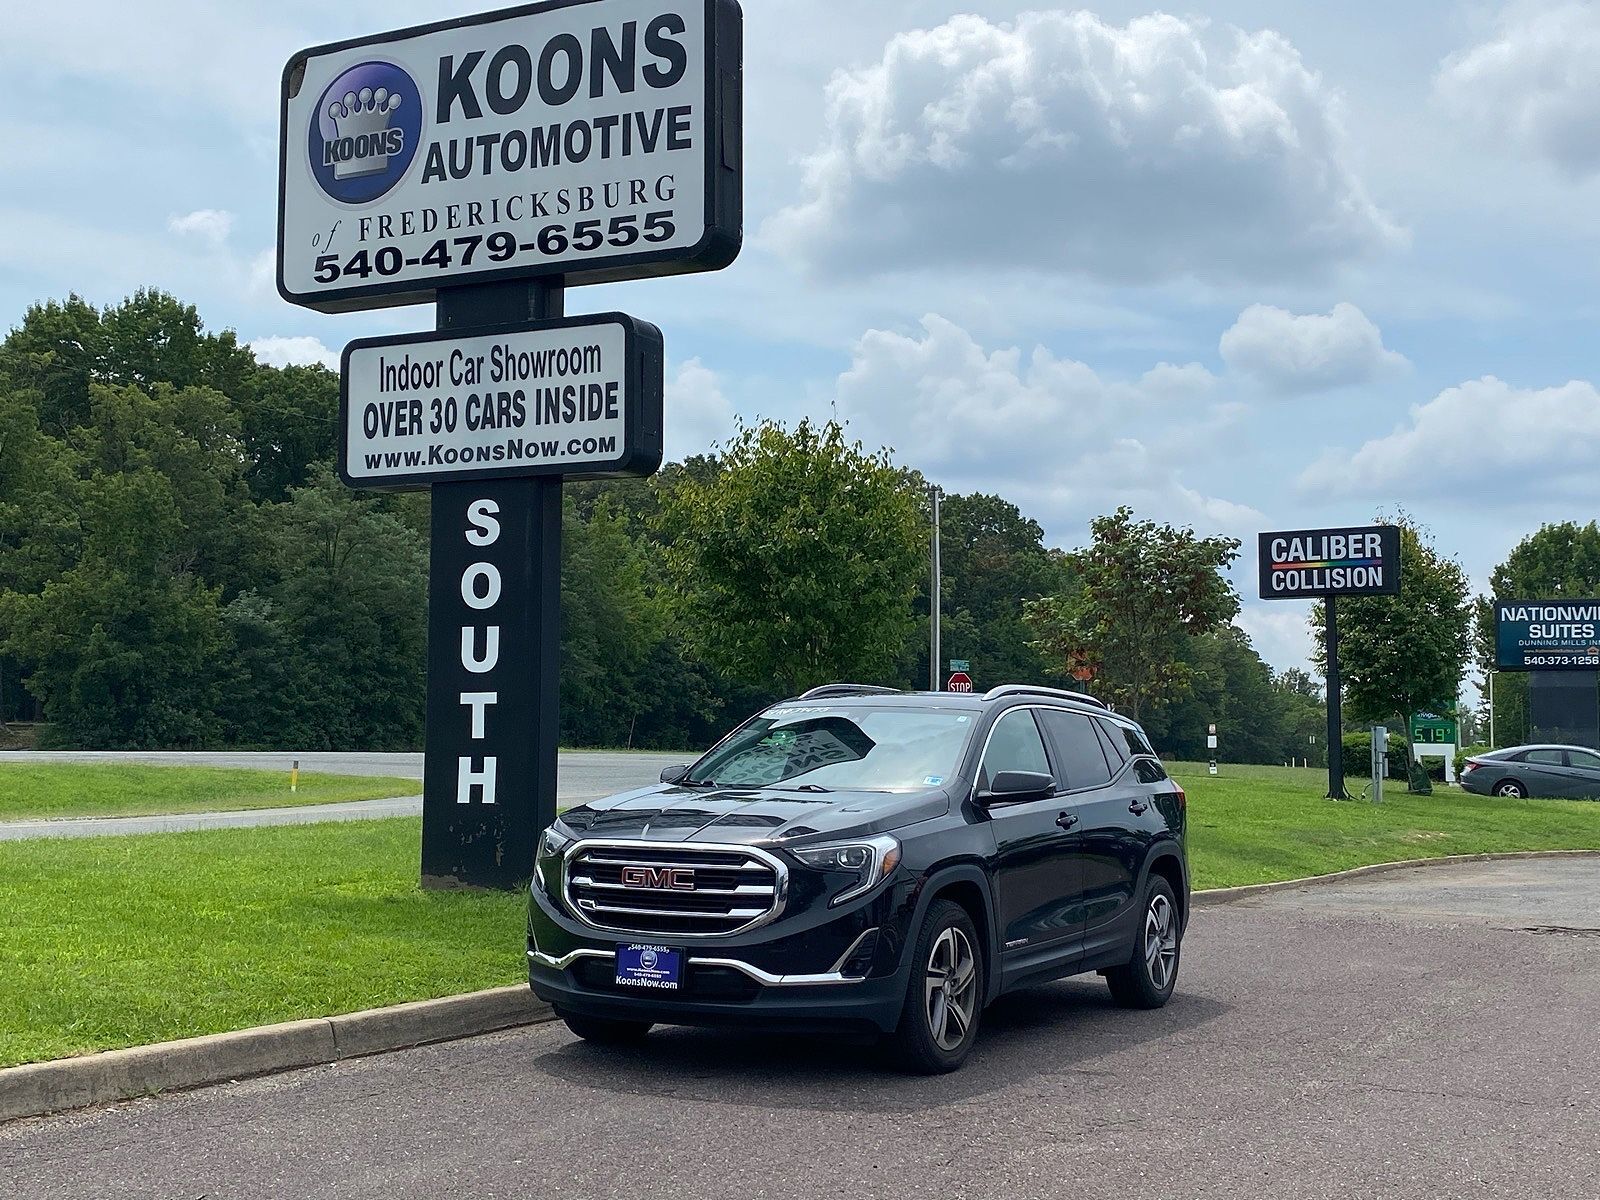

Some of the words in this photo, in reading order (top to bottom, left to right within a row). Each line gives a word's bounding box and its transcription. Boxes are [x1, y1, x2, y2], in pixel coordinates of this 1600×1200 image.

[436, 13, 688, 124] KOONS
[323, 128, 404, 166] KOONS
[421, 105, 692, 184] AUTOMOTIVE
[311, 220, 342, 254] of
[358, 174, 677, 242] FREDERICKSBURG
[313, 209, 676, 284] 540-479-6555
[379, 354, 444, 393] Indoor
[449, 348, 485, 387] Car
[490, 343, 601, 388] Showroom
[363, 399, 423, 440] OVER
[429, 396, 458, 434] 30
[465, 390, 526, 432] CARS
[535, 381, 619, 426] INSIDE
[1271, 533, 1383, 563] CALIBER
[1271, 566, 1383, 591] COLLISION
[1529, 624, 1595, 639] SUITES
[456, 499, 501, 804] SOUTH
[1524, 656, 1599, 665] 540-373-1256
[950, 682, 971, 692] STOP
[622, 866, 695, 890] GMC
[615, 975, 678, 990] KoonsNow.com
